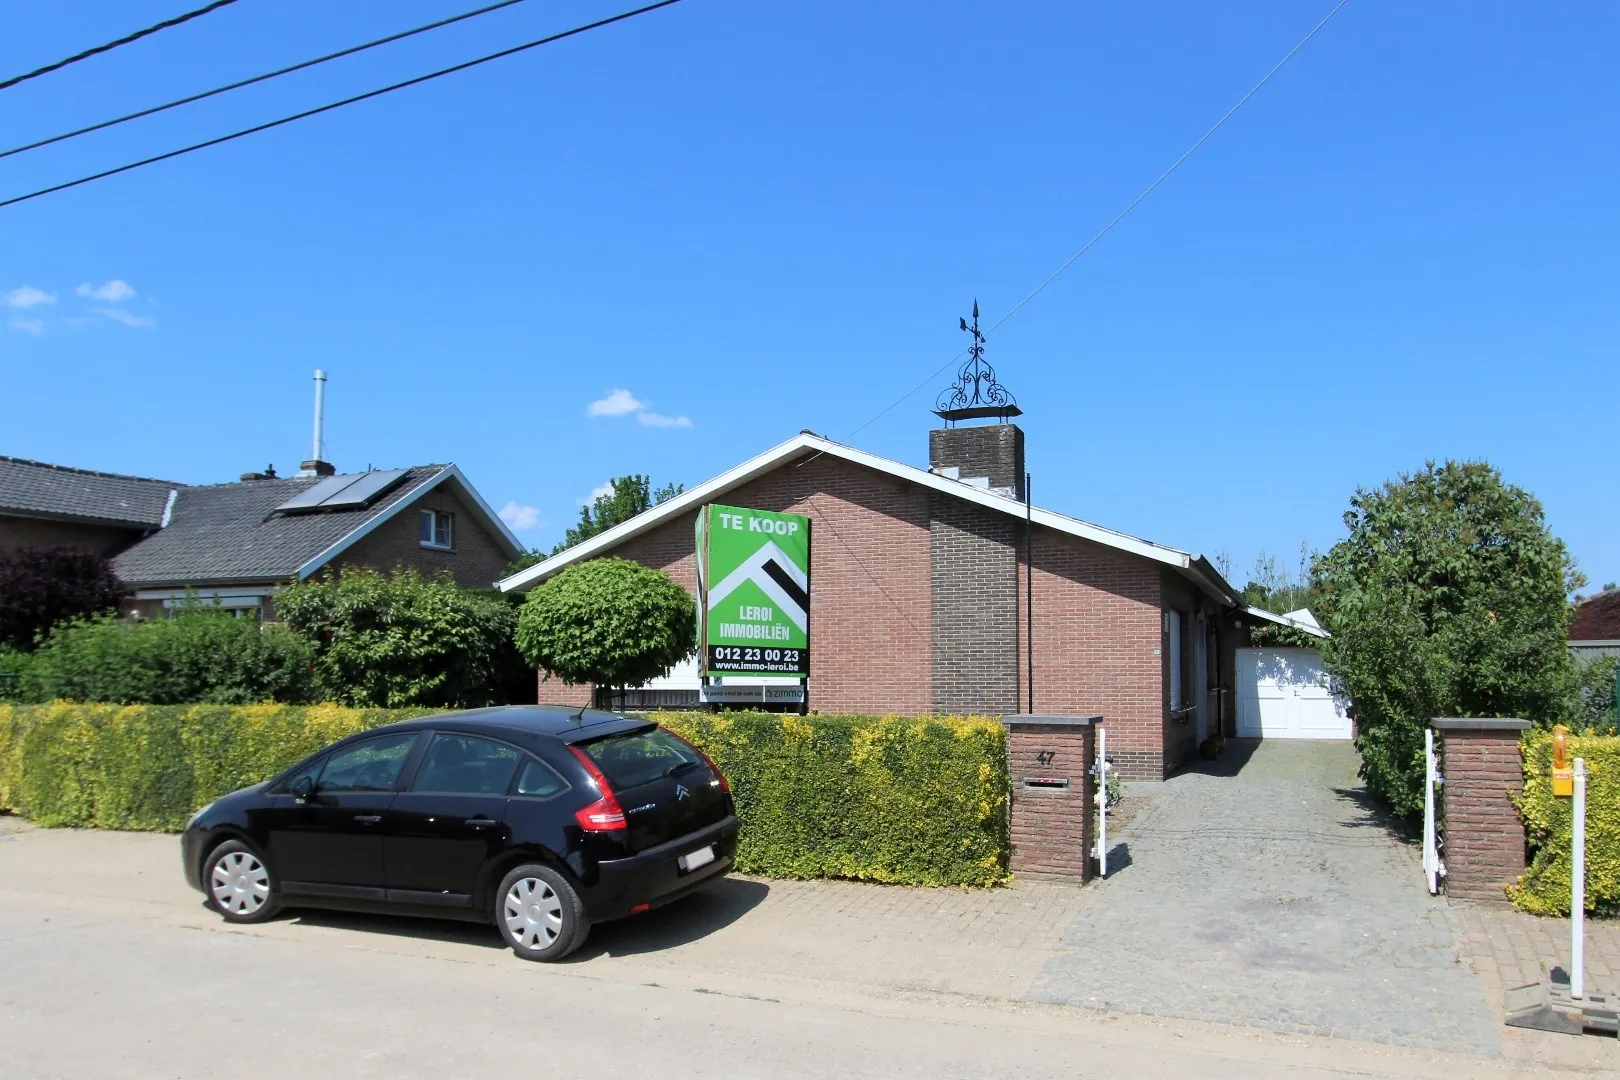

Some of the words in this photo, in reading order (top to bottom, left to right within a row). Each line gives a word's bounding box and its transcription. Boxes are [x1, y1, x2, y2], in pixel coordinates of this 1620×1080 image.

[719, 513, 743, 531] TE
[749, 516, 798, 536] KOOP
[739, 605, 772, 621] LEROI
[720, 622, 790, 640] IMMOBILIËN
[715, 647, 740, 660] 012
[744, 648, 760, 660] 23
[764, 649, 780, 661] 00
[783, 650, 799, 661] 23
[715, 661, 799, 671] www.immo-leroi.be
[774, 689, 803, 698] zimmo
[1037, 750, 1055, 765] 47
